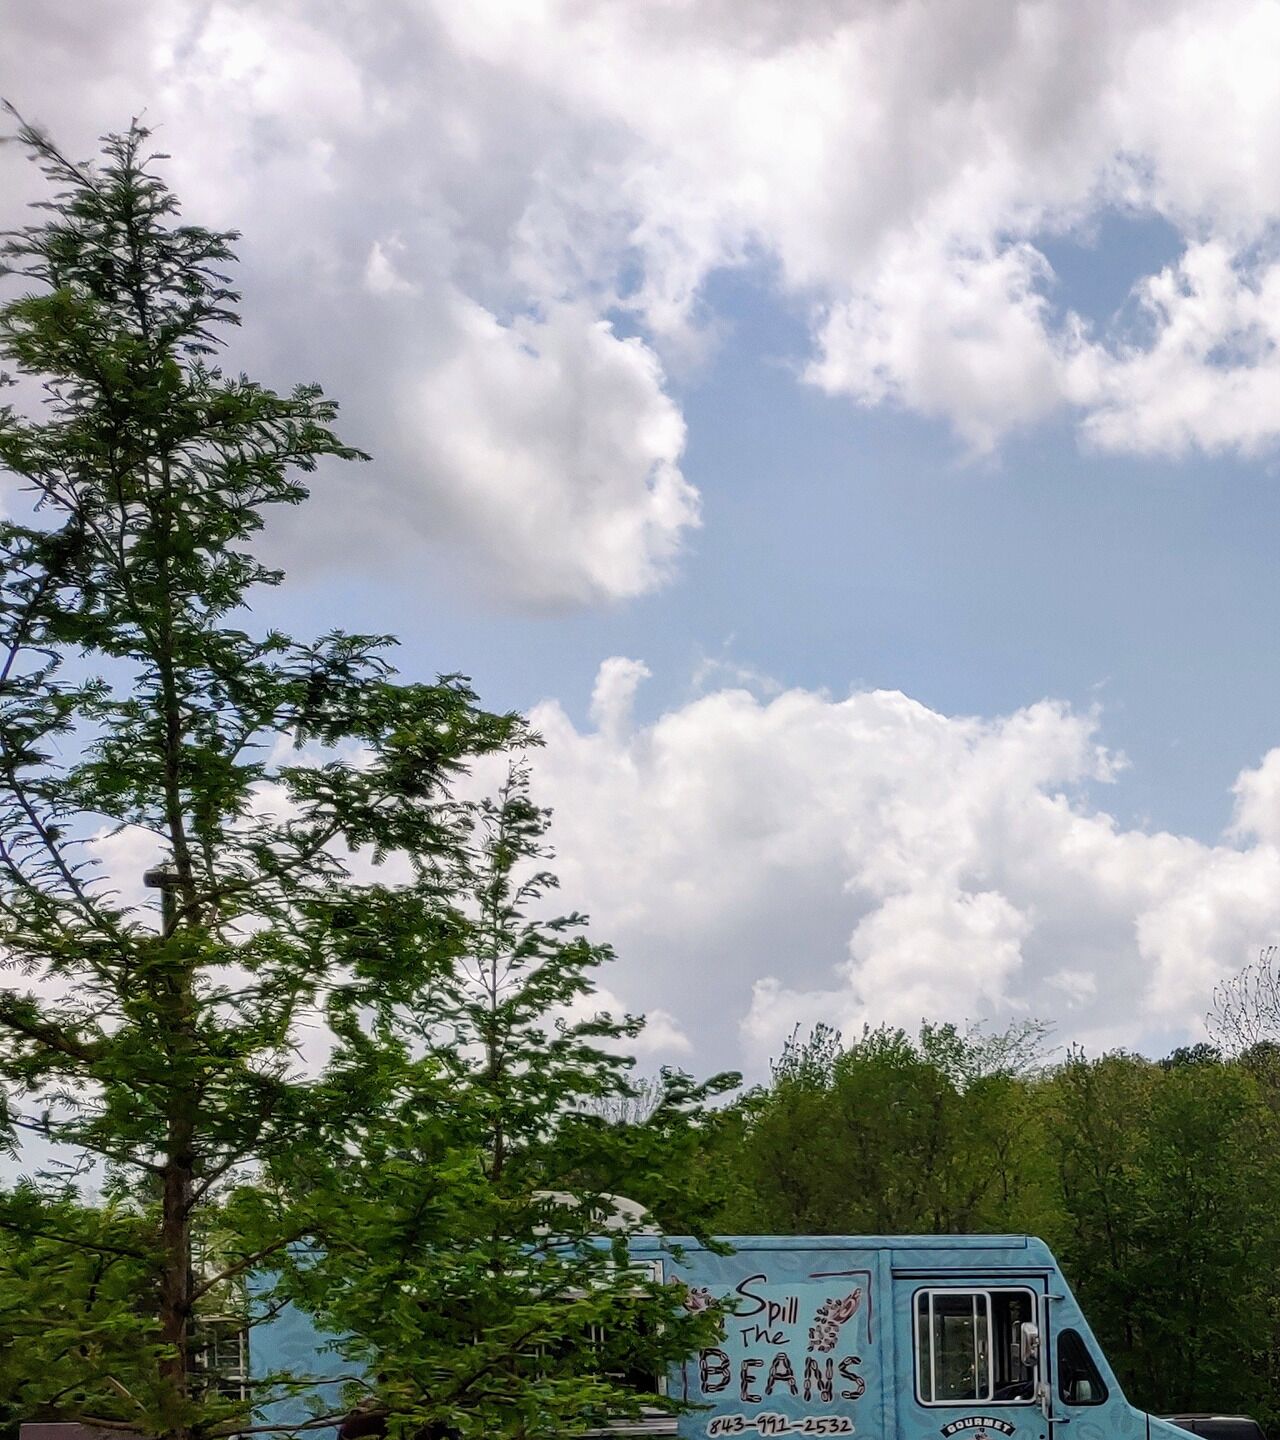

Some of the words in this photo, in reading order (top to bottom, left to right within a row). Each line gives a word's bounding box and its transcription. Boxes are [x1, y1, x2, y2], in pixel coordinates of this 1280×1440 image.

[734, 1275, 797, 1328] Spill
[740, 1324, 790, 1347] The
[700, 1348, 865, 1402] BEANS
[710, 1416, 852, 1433] 843-991-2532
[946, 1417, 1011, 1433] GOURMET
